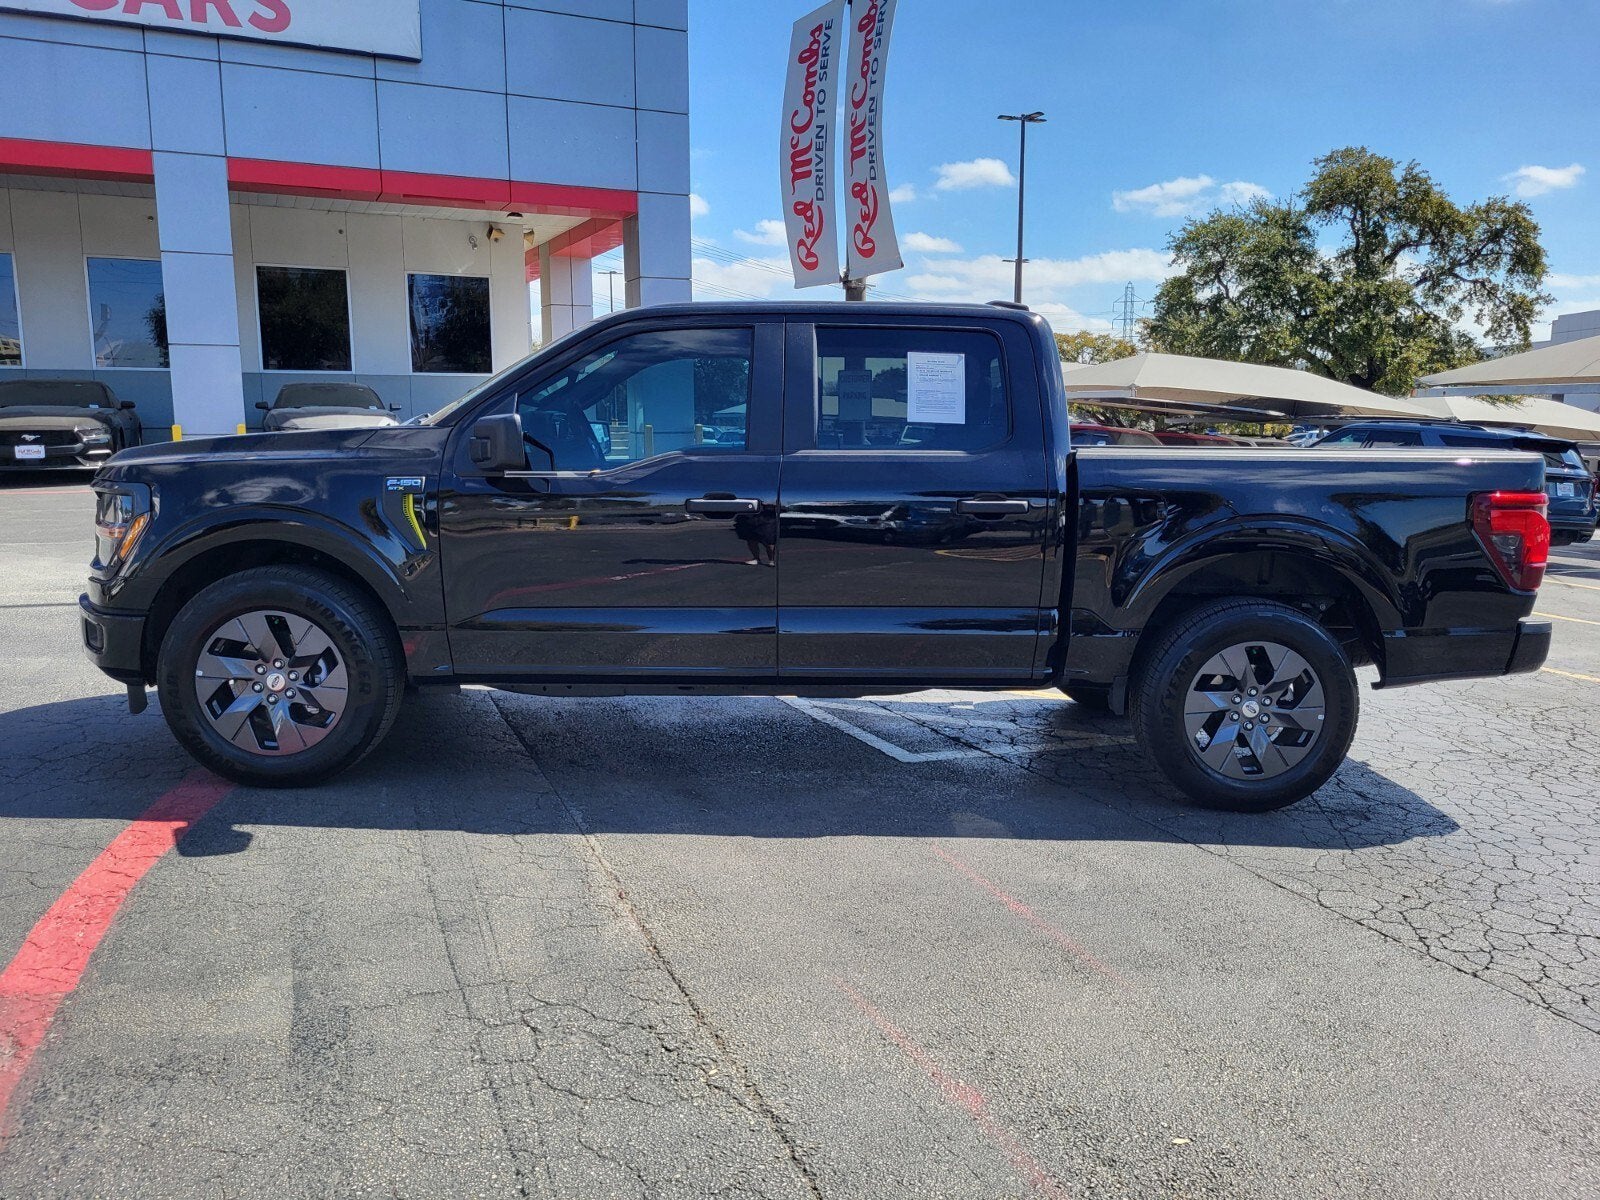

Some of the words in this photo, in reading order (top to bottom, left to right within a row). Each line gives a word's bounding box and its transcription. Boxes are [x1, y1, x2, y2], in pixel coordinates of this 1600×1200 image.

[819, 18, 834, 82] SERVE
[873, 0, 888, 50] SERV
[790, 23, 824, 195] McCombs
[816, 88, 827, 118] TO
[850, 0, 879, 177] McComb
[869, 57, 879, 90] TO
[815, 124, 825, 202] DRIVEN
[867, 96, 877, 181] DRIVEN
[793, 198, 824, 271] Red
[851, 177, 879, 258] Red
[305, 596, 373, 696] WRANGLER
